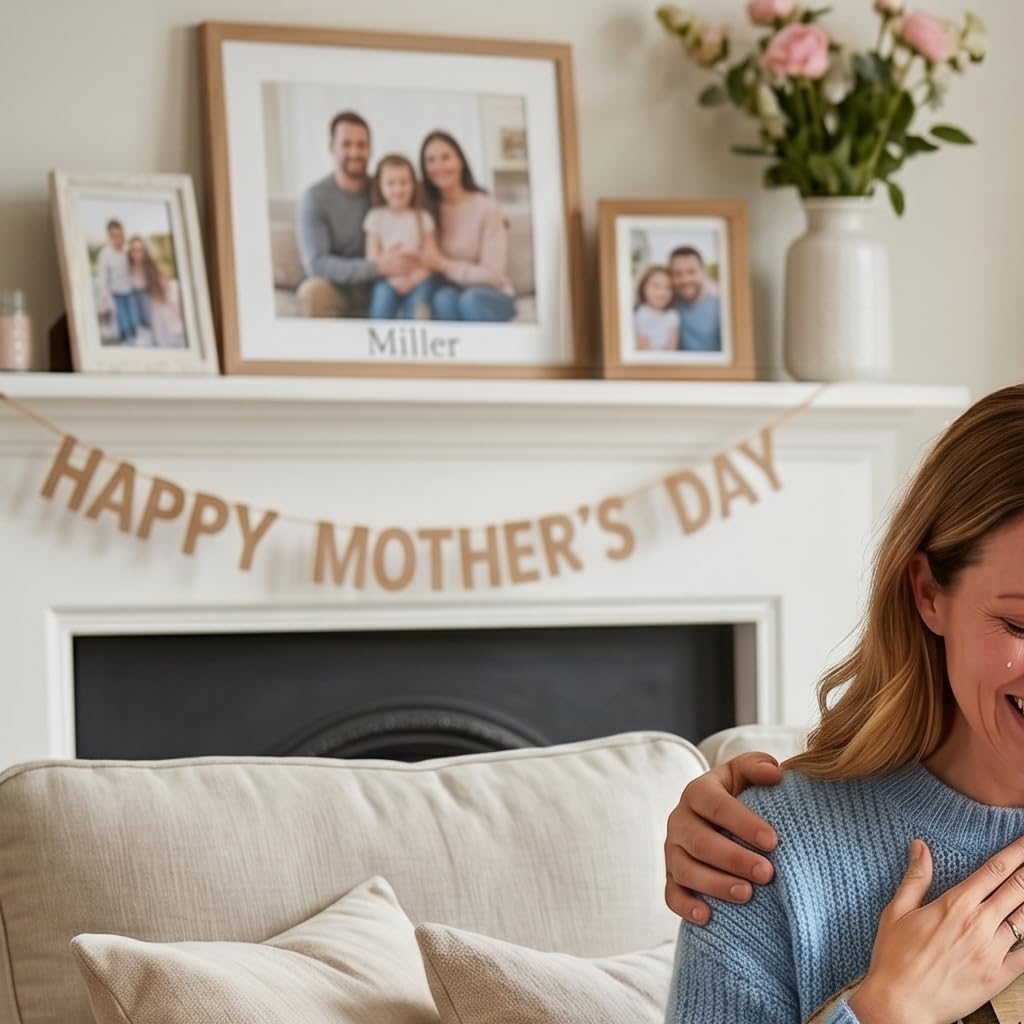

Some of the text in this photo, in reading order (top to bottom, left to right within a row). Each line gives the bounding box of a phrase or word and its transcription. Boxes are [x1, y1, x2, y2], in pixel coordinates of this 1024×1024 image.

[367, 326, 461, 357] Miller
[40, 427, 784, 592] HAPPY MOTHER'S DAY
